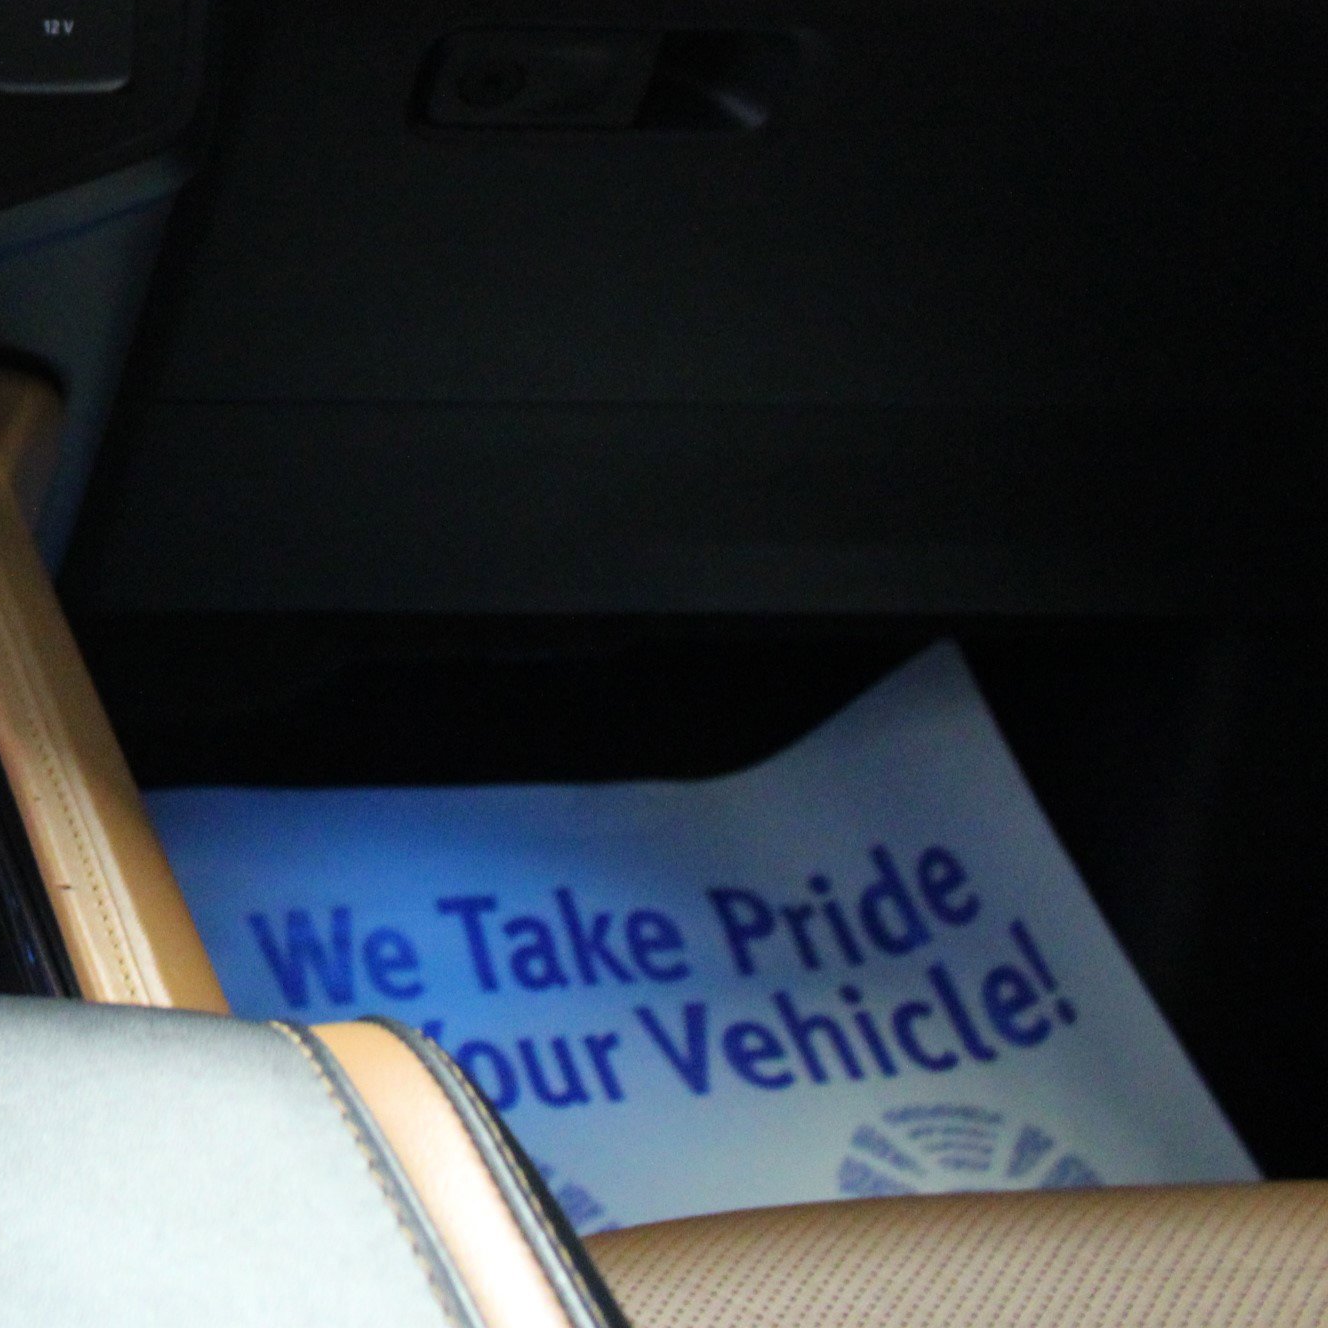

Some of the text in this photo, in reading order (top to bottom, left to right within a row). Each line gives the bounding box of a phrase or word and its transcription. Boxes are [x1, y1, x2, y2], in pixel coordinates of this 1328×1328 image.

[249, 842, 982, 1009] We Take Pride
[422, 918, 1077, 1112] our Vehicle!
